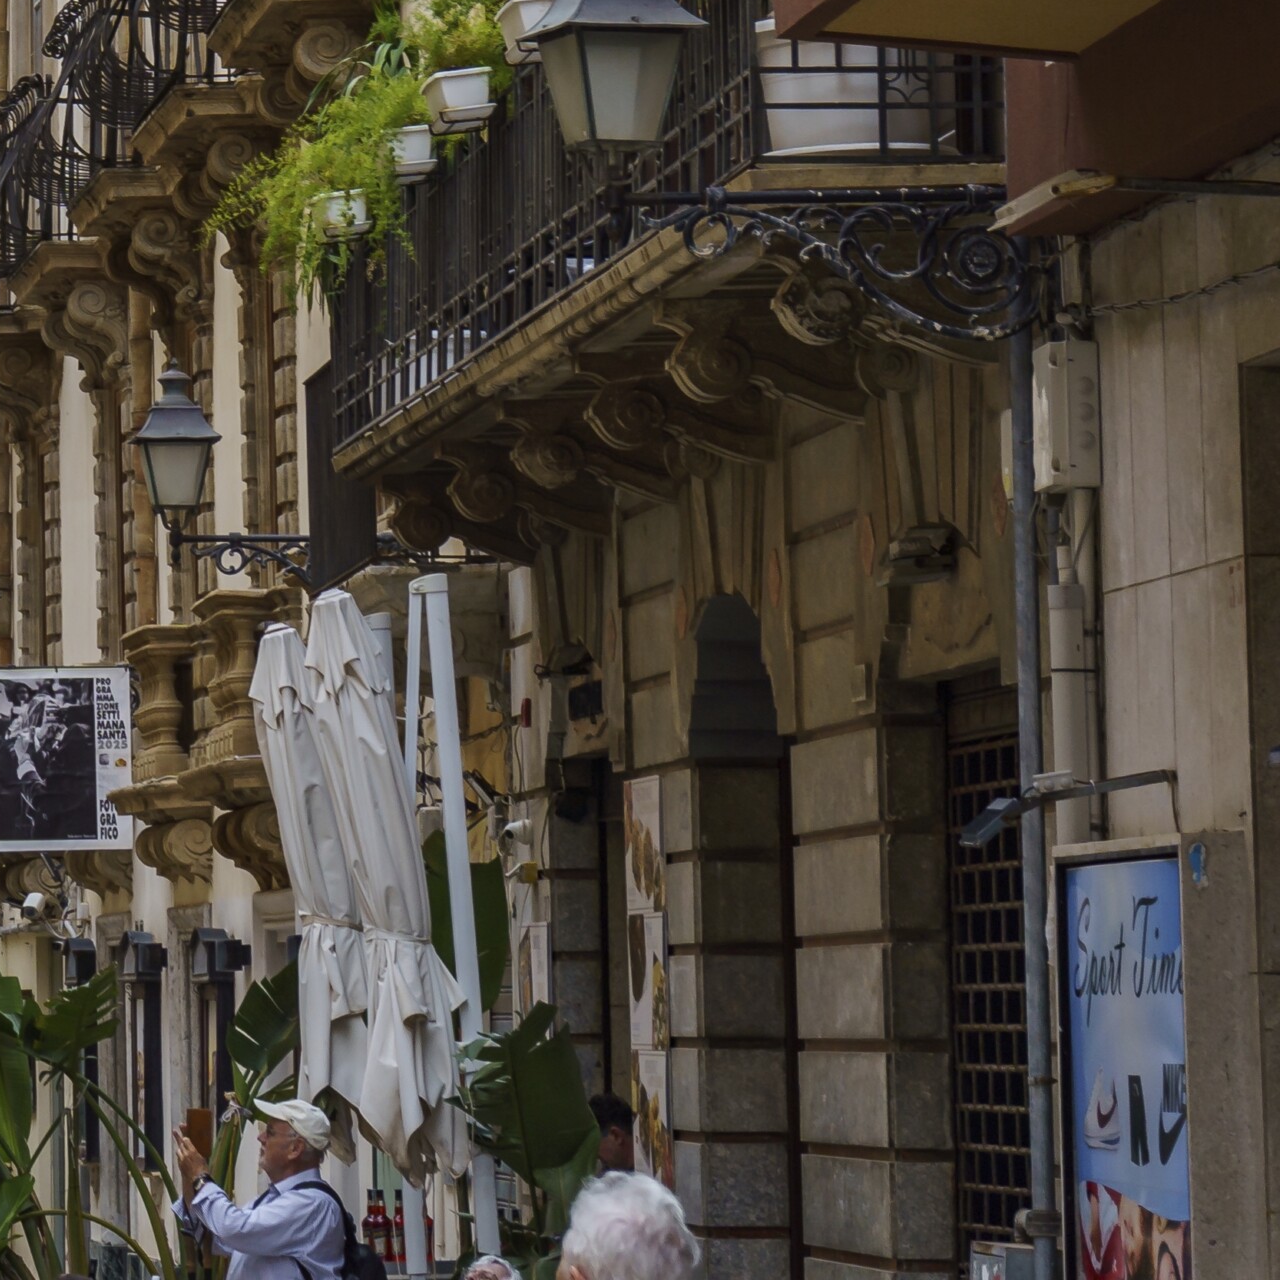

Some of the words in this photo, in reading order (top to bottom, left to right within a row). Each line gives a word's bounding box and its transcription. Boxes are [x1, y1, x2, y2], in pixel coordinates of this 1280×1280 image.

[96, 678, 111, 686] PRO
[96, 686, 111, 694] GRA
[96, 694, 115, 702] MMA
[96, 702, 119, 711] ZIONE
[97, 711, 120, 720] SETTI
[97, 720, 125, 730] MANA
[97, 730, 127, 740] SANTA
[98, 740, 128, 749] 2025
[99, 800, 115, 812] FOT
[100, 813, 117, 826] GRA
[100, 826, 118, 840] FICO
[1074, 897, 1125, 1028] Sport
